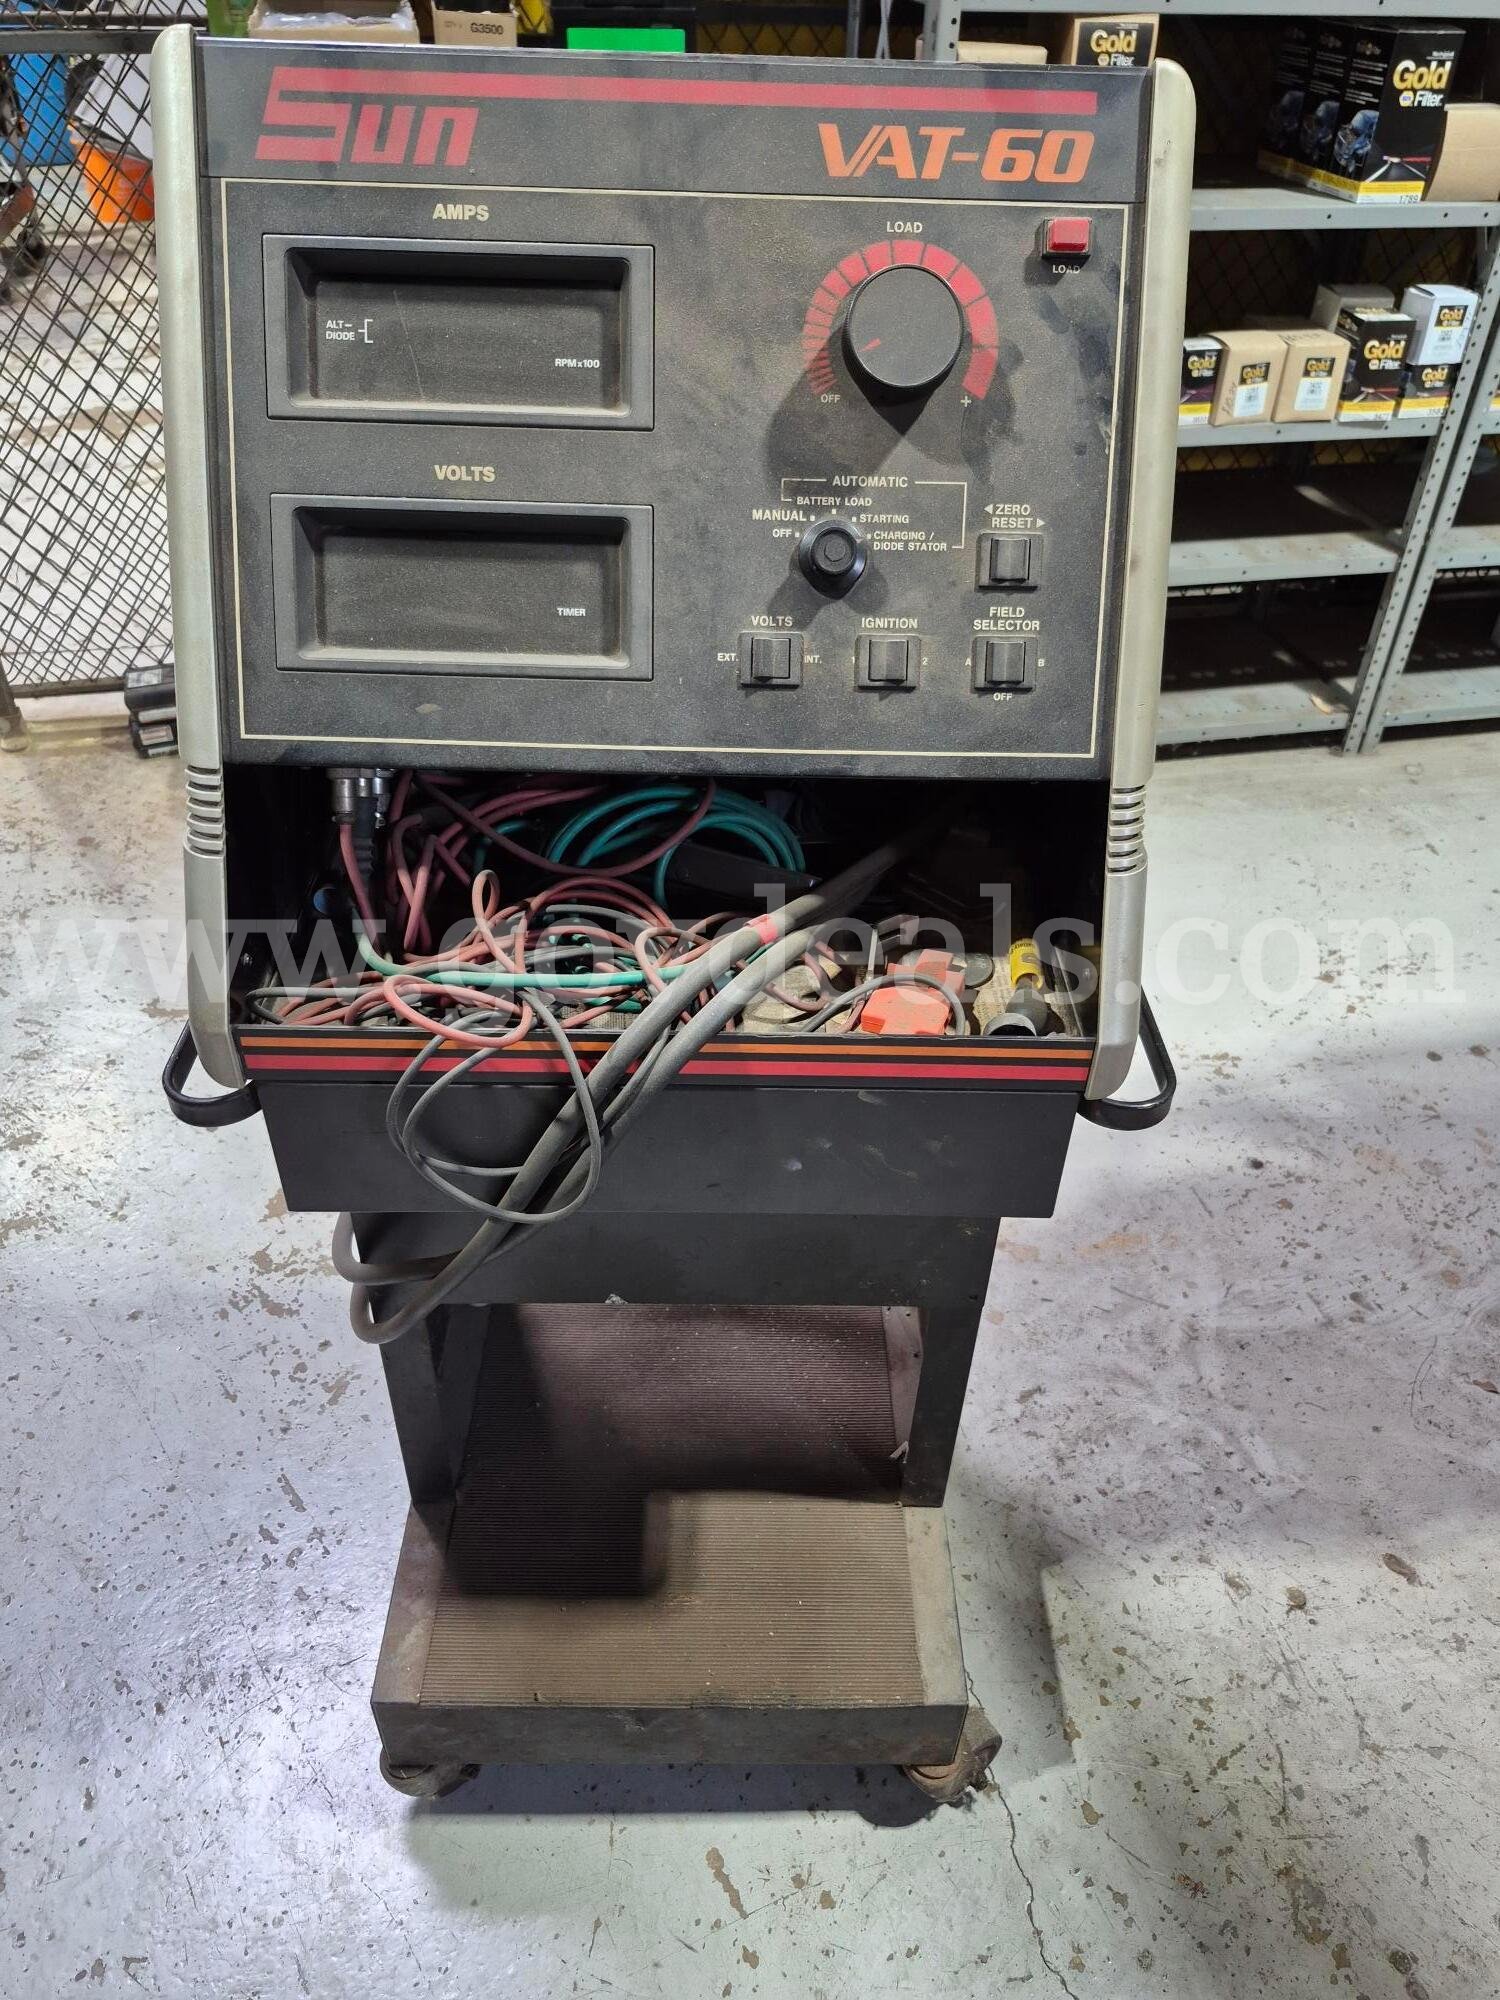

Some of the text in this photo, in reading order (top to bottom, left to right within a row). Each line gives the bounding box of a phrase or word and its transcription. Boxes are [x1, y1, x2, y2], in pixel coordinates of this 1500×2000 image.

[470, 22, 504, 35] G3500
[1090, 29, 1138, 53] Gold
[1393, 59, 1452, 90] Gold
[818, 122, 1096, 183] VAT-60
[432, 203, 490, 222] AMPS
[886, 221, 923, 233] LOAD
[1052, 264, 1081, 274] LOAD
[1440, 308, 1463, 321] Gold
[326, 331, 355, 341] DIODE
[1364, 339, 1406, 359] Gold
[1188, 355, 1217, 370] Gold
[1307, 360, 1331, 372] Gold
[1243, 366, 1265, 379] Gold
[1422, 367, 1448, 382] Gold
[821, 394, 840, 404] OFF
[434, 464, 496, 482] VOLTS
[832, 475, 909, 488] AUTOMATIC
[796, 496, 872, 507] BATTERY LOAD
[752, 509, 806, 522] MANUAL
[995, 504, 1030, 516] ZERO
[859, 514, 909, 524] STARTING
[991, 517, 1033, 529] RESET
[772, 529, 792, 538] OFF
[873, 531, 926, 541] CHARGING
[873, 541, 947, 552] DIODE STATOR
[557, 607, 586, 617] TIMER
[989, 606, 1025, 618] FIELD
[751, 615, 793, 628] VOLTS
[861, 617, 918, 629] IGNITION
[973, 619, 1040, 631] SELECTOR
[717, 652, 738, 662] EXT.
[804, 655, 822, 664] INT.
[922, 656, 928, 665] 2
[964, 657, 972, 666] A
[1037, 658, 1045, 667] B
[993, 692, 1013, 701] OFF
